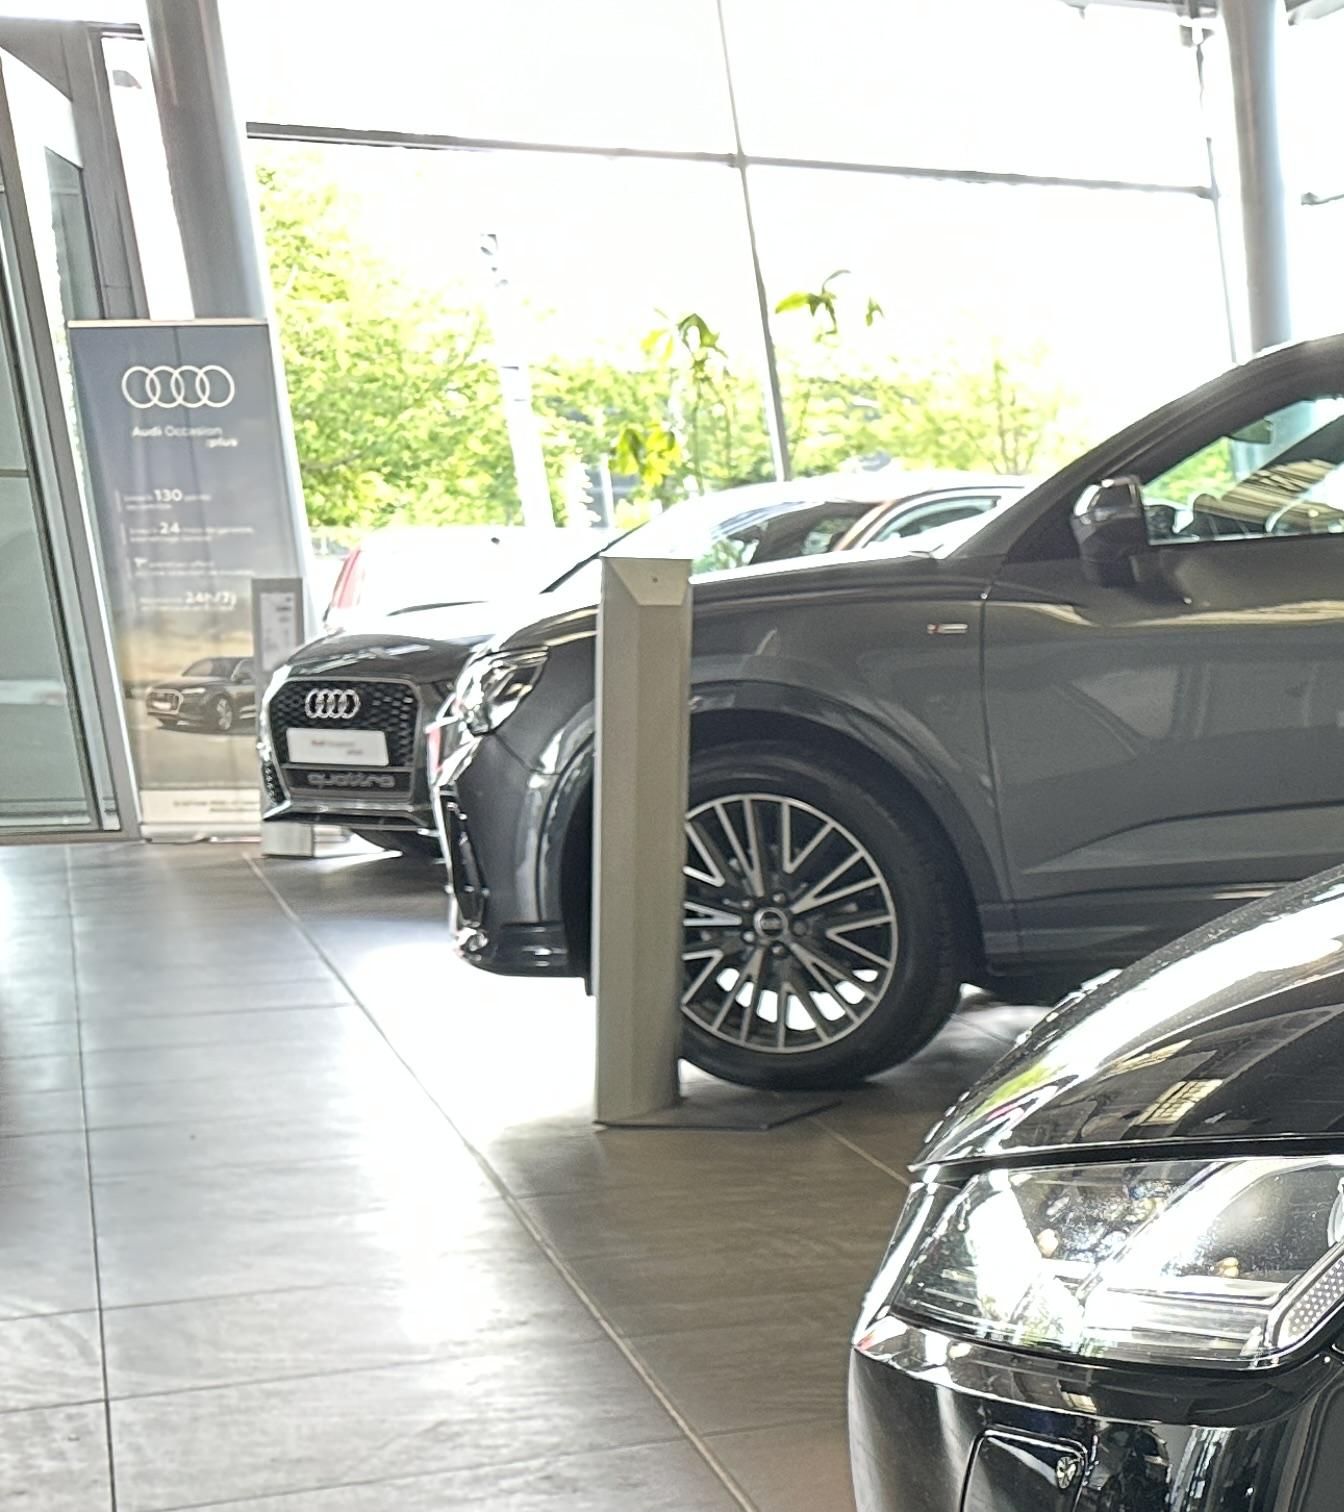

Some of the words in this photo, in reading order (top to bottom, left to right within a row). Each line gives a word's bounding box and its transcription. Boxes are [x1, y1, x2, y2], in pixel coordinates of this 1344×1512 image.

[132, 426, 163, 437] Audi
[154, 489, 183, 501] 130
[160, 522, 180, 534] 24
[307, 772, 396, 789] quattro
